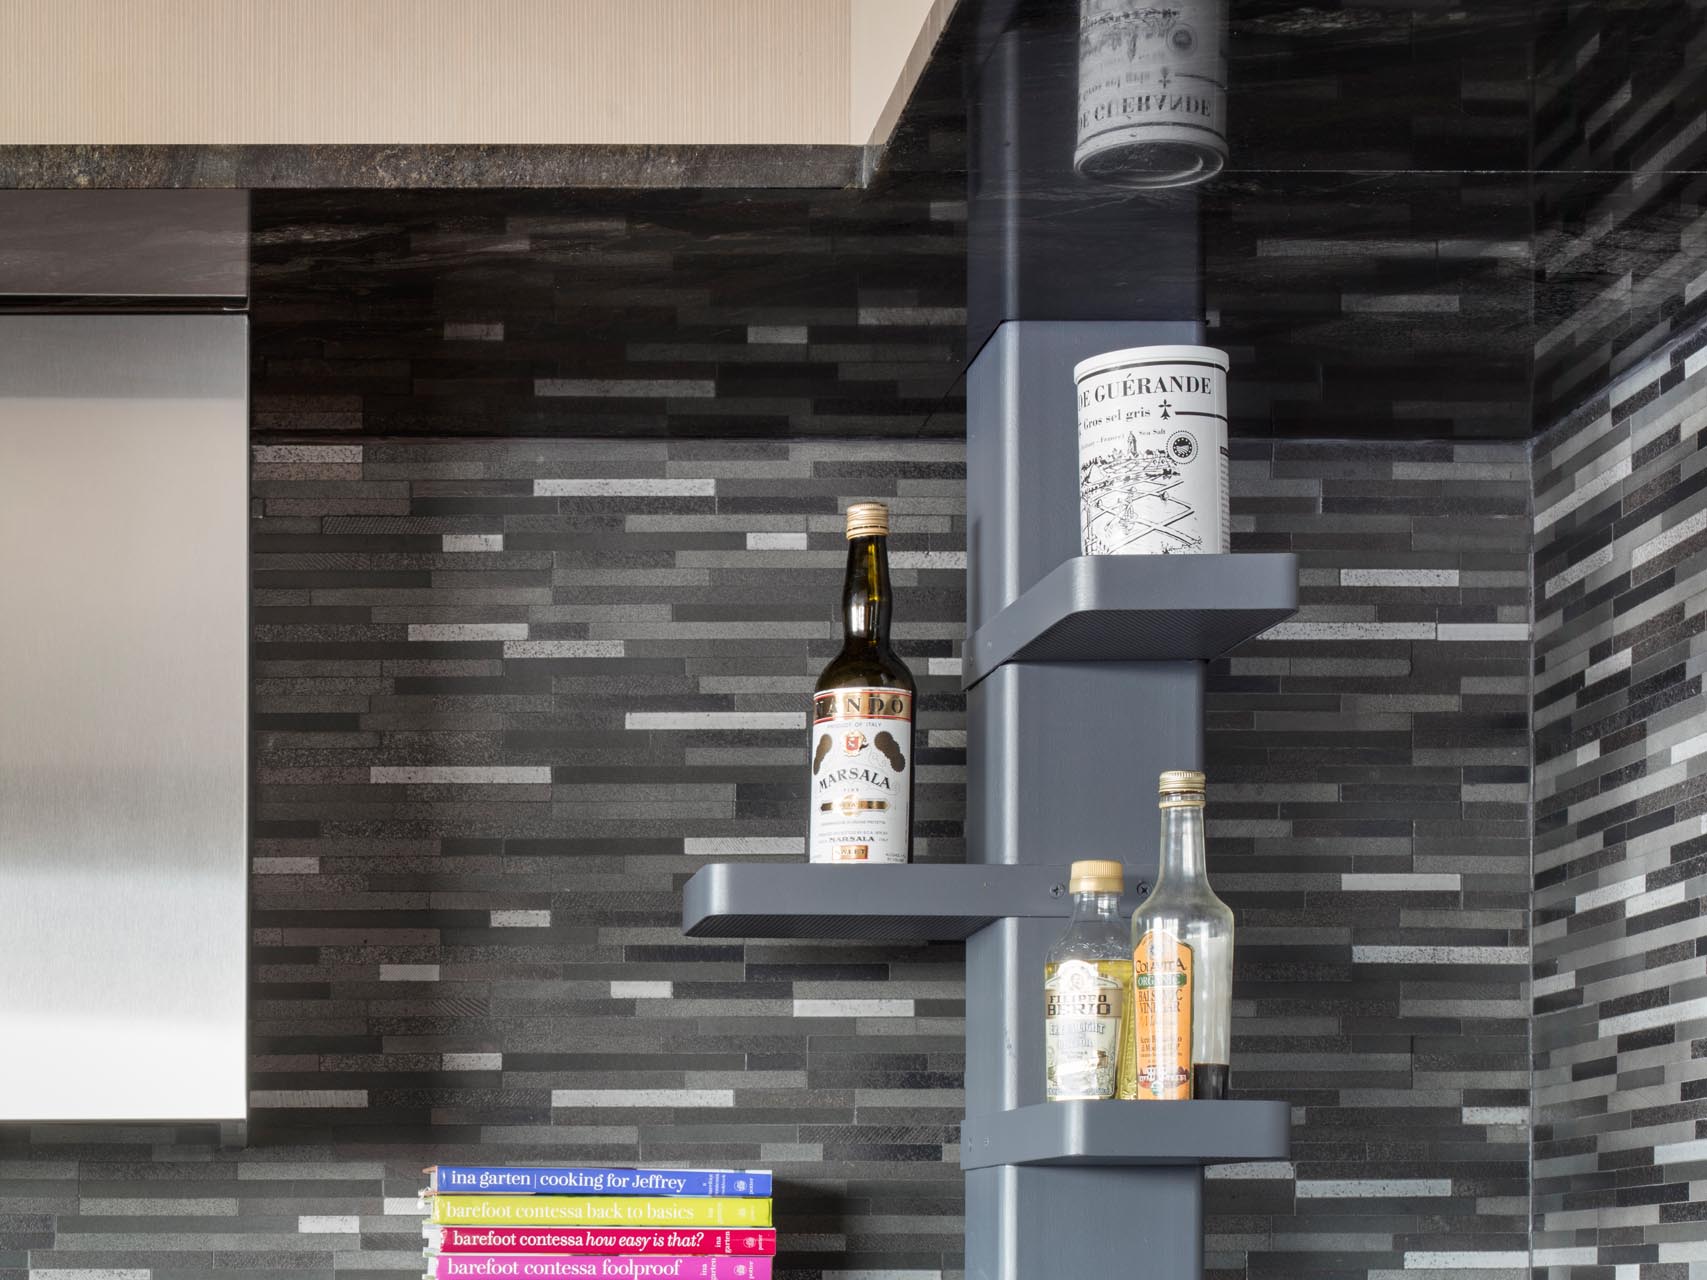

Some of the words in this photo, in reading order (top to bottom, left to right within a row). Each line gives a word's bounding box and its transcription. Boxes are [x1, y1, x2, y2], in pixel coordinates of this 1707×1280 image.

[1094, 373, 1212, 402] GUÉRANDE
[1083, 415, 1103, 430] Gros
[1106, 409, 1121, 422] sel
[1126, 406, 1150, 422] gris
[819, 768, 891, 793] MARSALA
[451, 1171, 476, 1185] ina
[480, 1171, 531, 1188] garten
[540, 1173, 604, 1190] cooking
[607, 1173, 630, 1188] for
[632, 1175, 687, 1193] Jeffrey
[447, 1202, 512, 1218] barefoot
[515, 1206, 583, 1218] contessa
[587, 1202, 623, 1219] back
[627, 1205, 643, 1219] to
[647, 1202, 694, 1219] basics
[453, 1230, 516, 1246] barefoot
[519, 1234, 583, 1246] contessa
[586, 1231, 616, 1246] how
[618, 1236, 650, 1251] easy
[653, 1233, 665, 1247] is
[667, 1232, 704, 1247] that?
[447, 1258, 519, 1275] barefoot
[524, 1262, 597, 1275] contessa
[602, 1258, 683, 1280] foolproof
